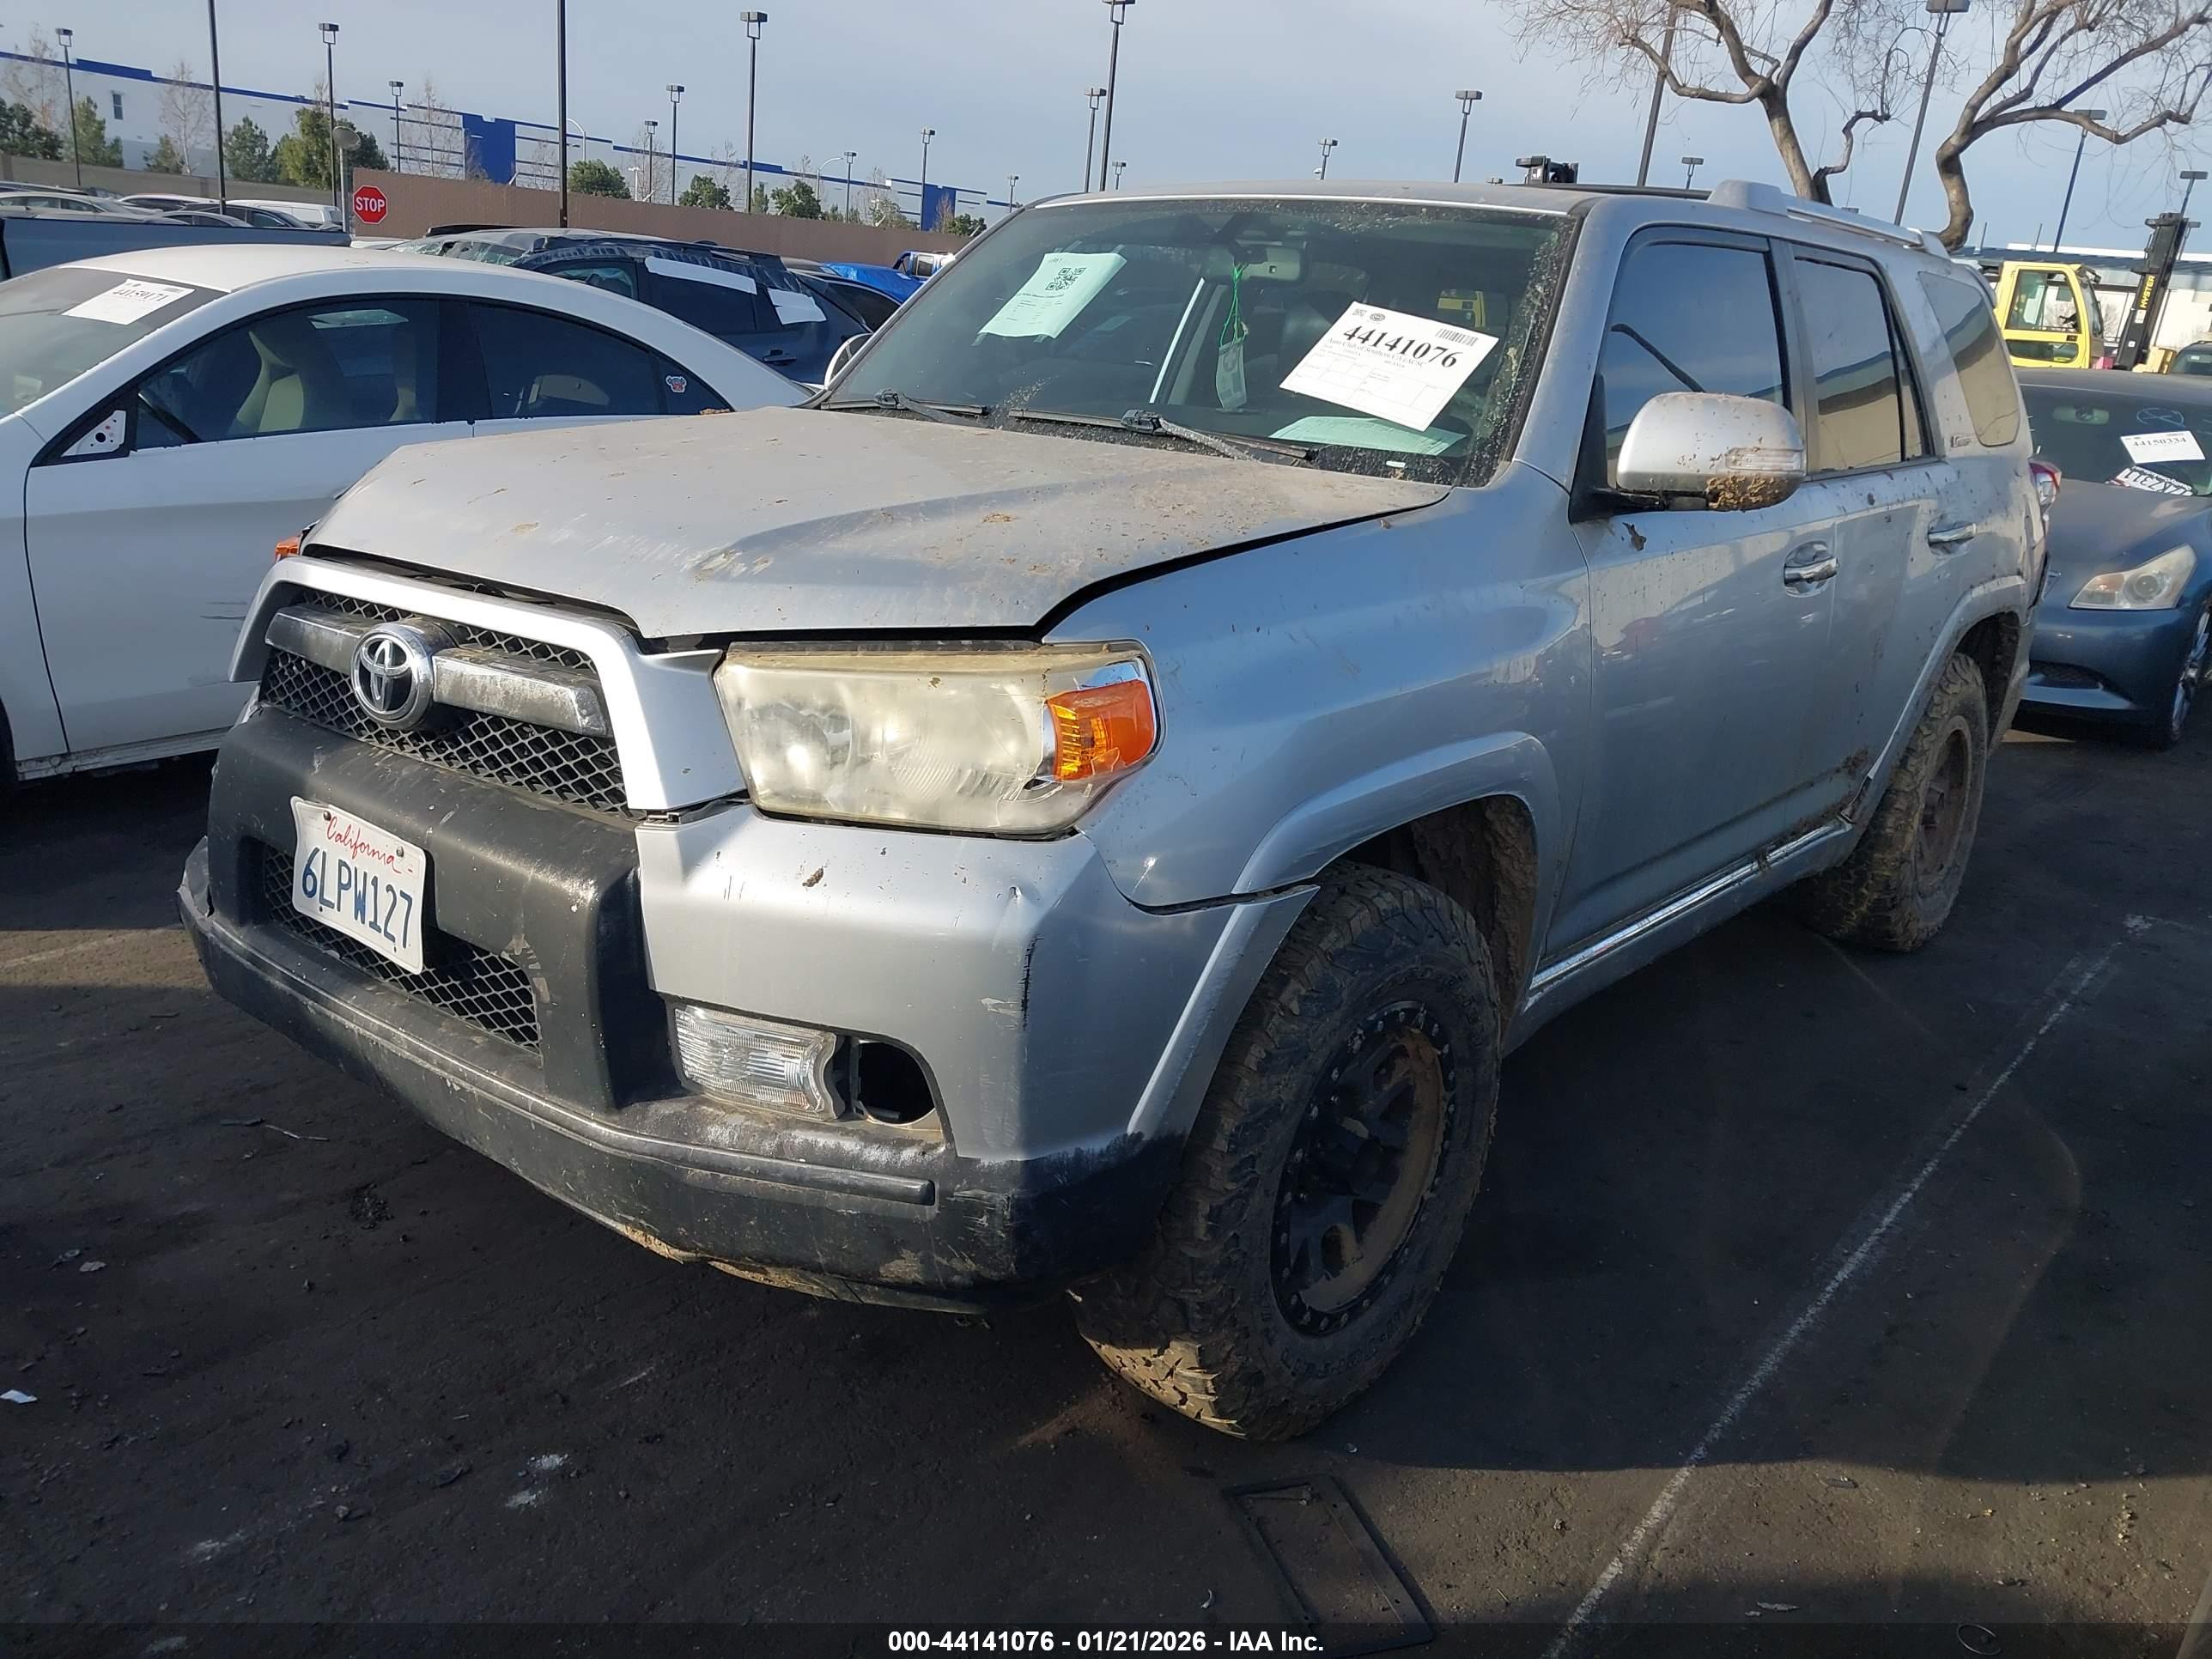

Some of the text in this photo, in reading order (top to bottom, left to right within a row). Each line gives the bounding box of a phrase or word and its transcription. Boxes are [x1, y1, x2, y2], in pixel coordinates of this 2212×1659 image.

[356, 197, 385, 213] STOP
[2140, 275, 2156, 308] HYSTER
[1343, 325, 1463, 368] 44141076
[2132, 437, 2188, 447] 44150334
[325, 816, 403, 874] California
[301, 847, 413, 949] 6LPW127
